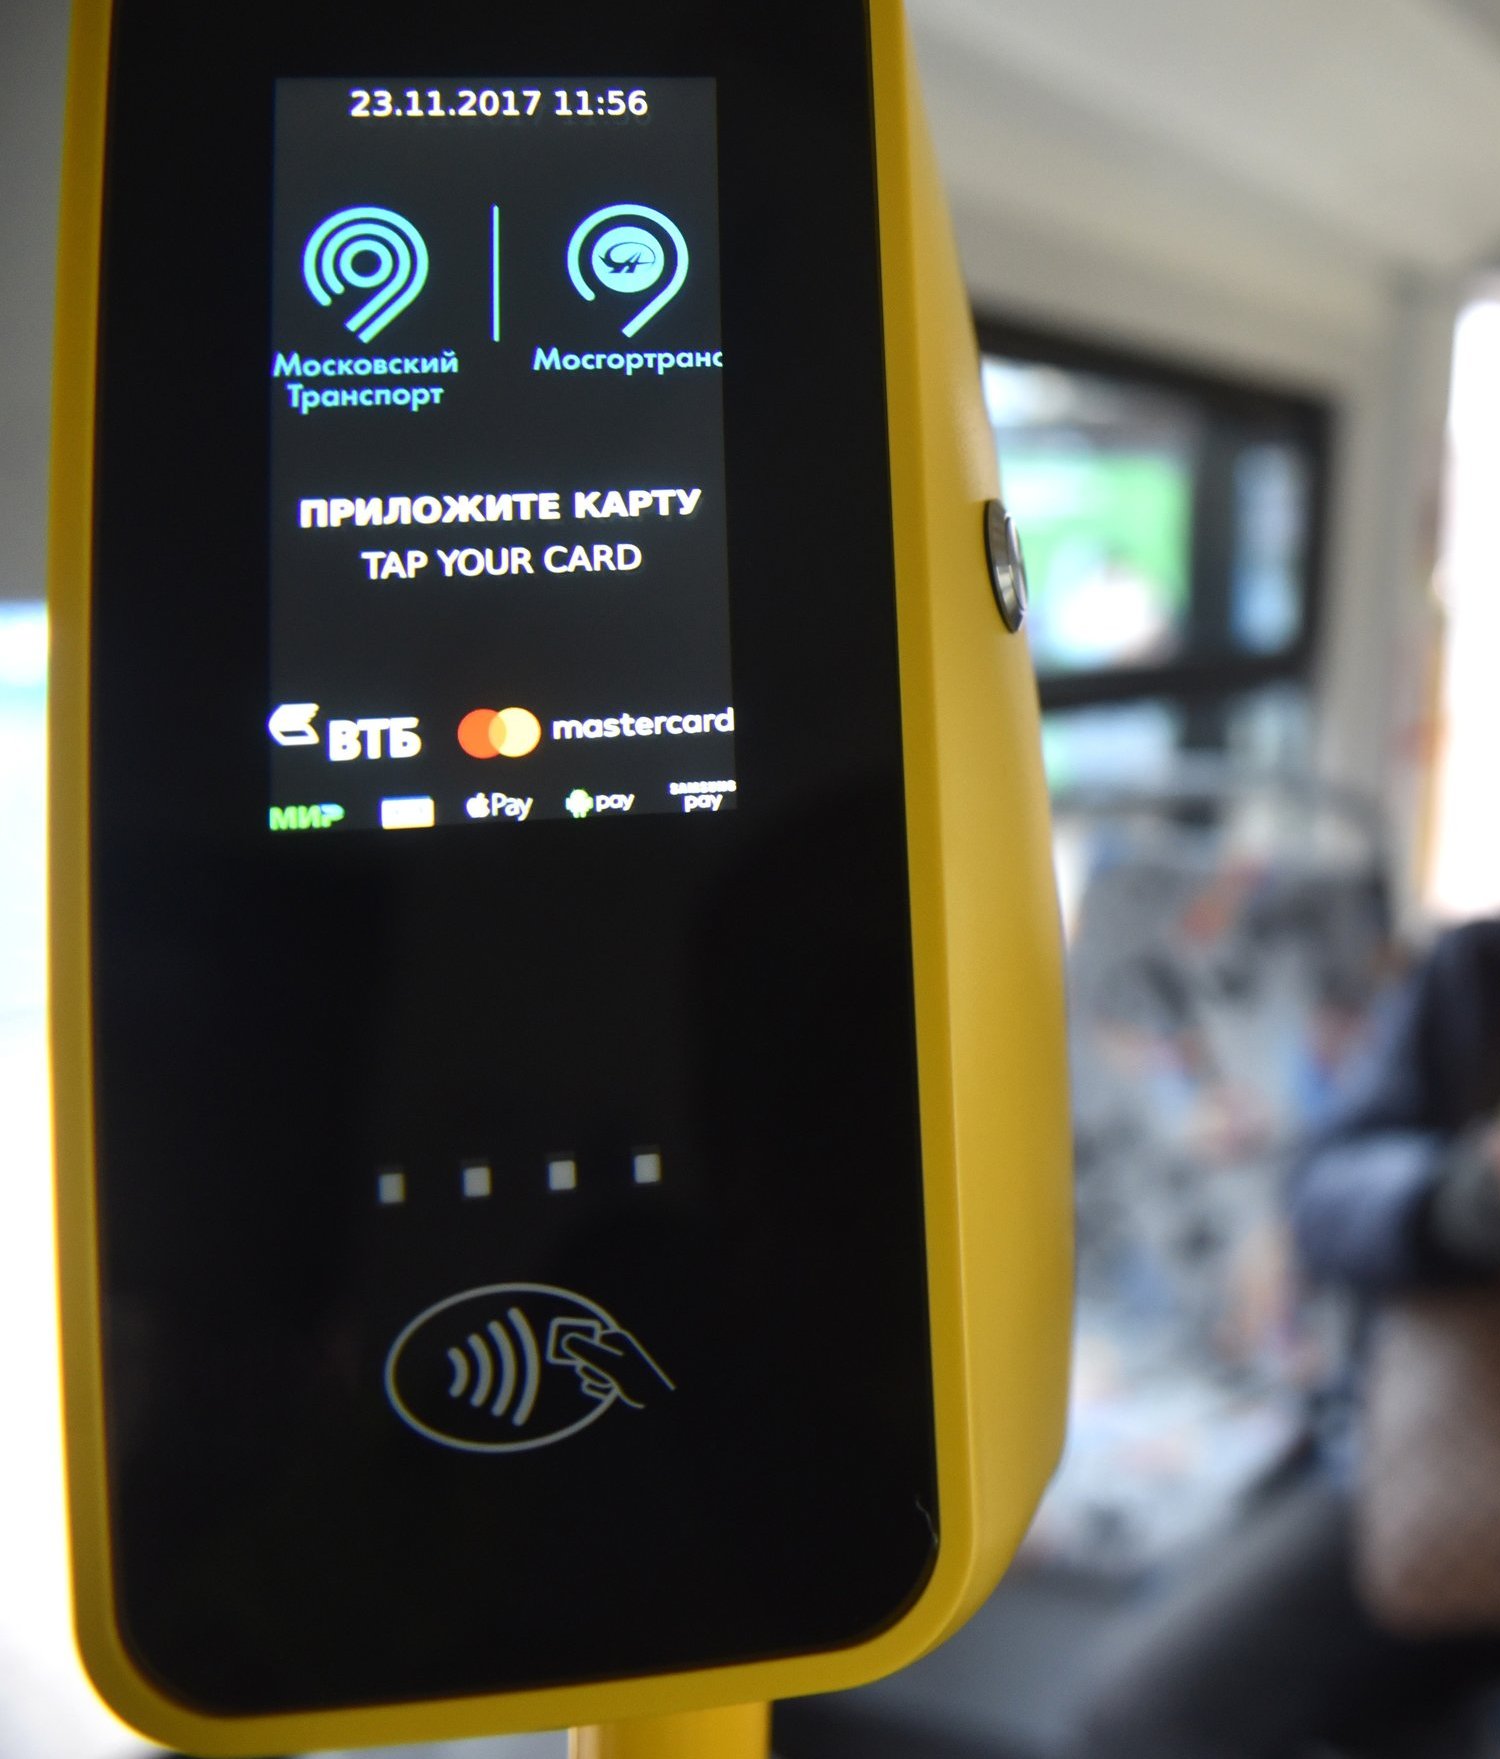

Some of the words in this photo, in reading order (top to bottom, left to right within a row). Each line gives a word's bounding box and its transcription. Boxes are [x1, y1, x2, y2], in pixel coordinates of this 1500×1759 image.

[349, 88, 541, 117] 23.11.2017
[554, 88, 648, 116] 11:56
[271, 350, 459, 378] Московский
[531, 345, 723, 376] Мосгортранс
[285, 382, 444, 415] Транспорт
[298, 492, 561, 528] ПРИЛОЖИТЕ
[572, 488, 702, 519] КАРТУ
[359, 549, 428, 580] TAP
[435, 546, 534, 577] YOUR
[542, 543, 643, 574] CARD
[551, 706, 735, 740] mastercard
[326, 716, 422, 762] ВТБ
[668, 780, 737, 795] SAMSUNG
[269, 803, 345, 831] МИР
[491, 792, 533, 821] Pay
[595, 794, 635, 812] pay
[683, 794, 723, 813] pay
